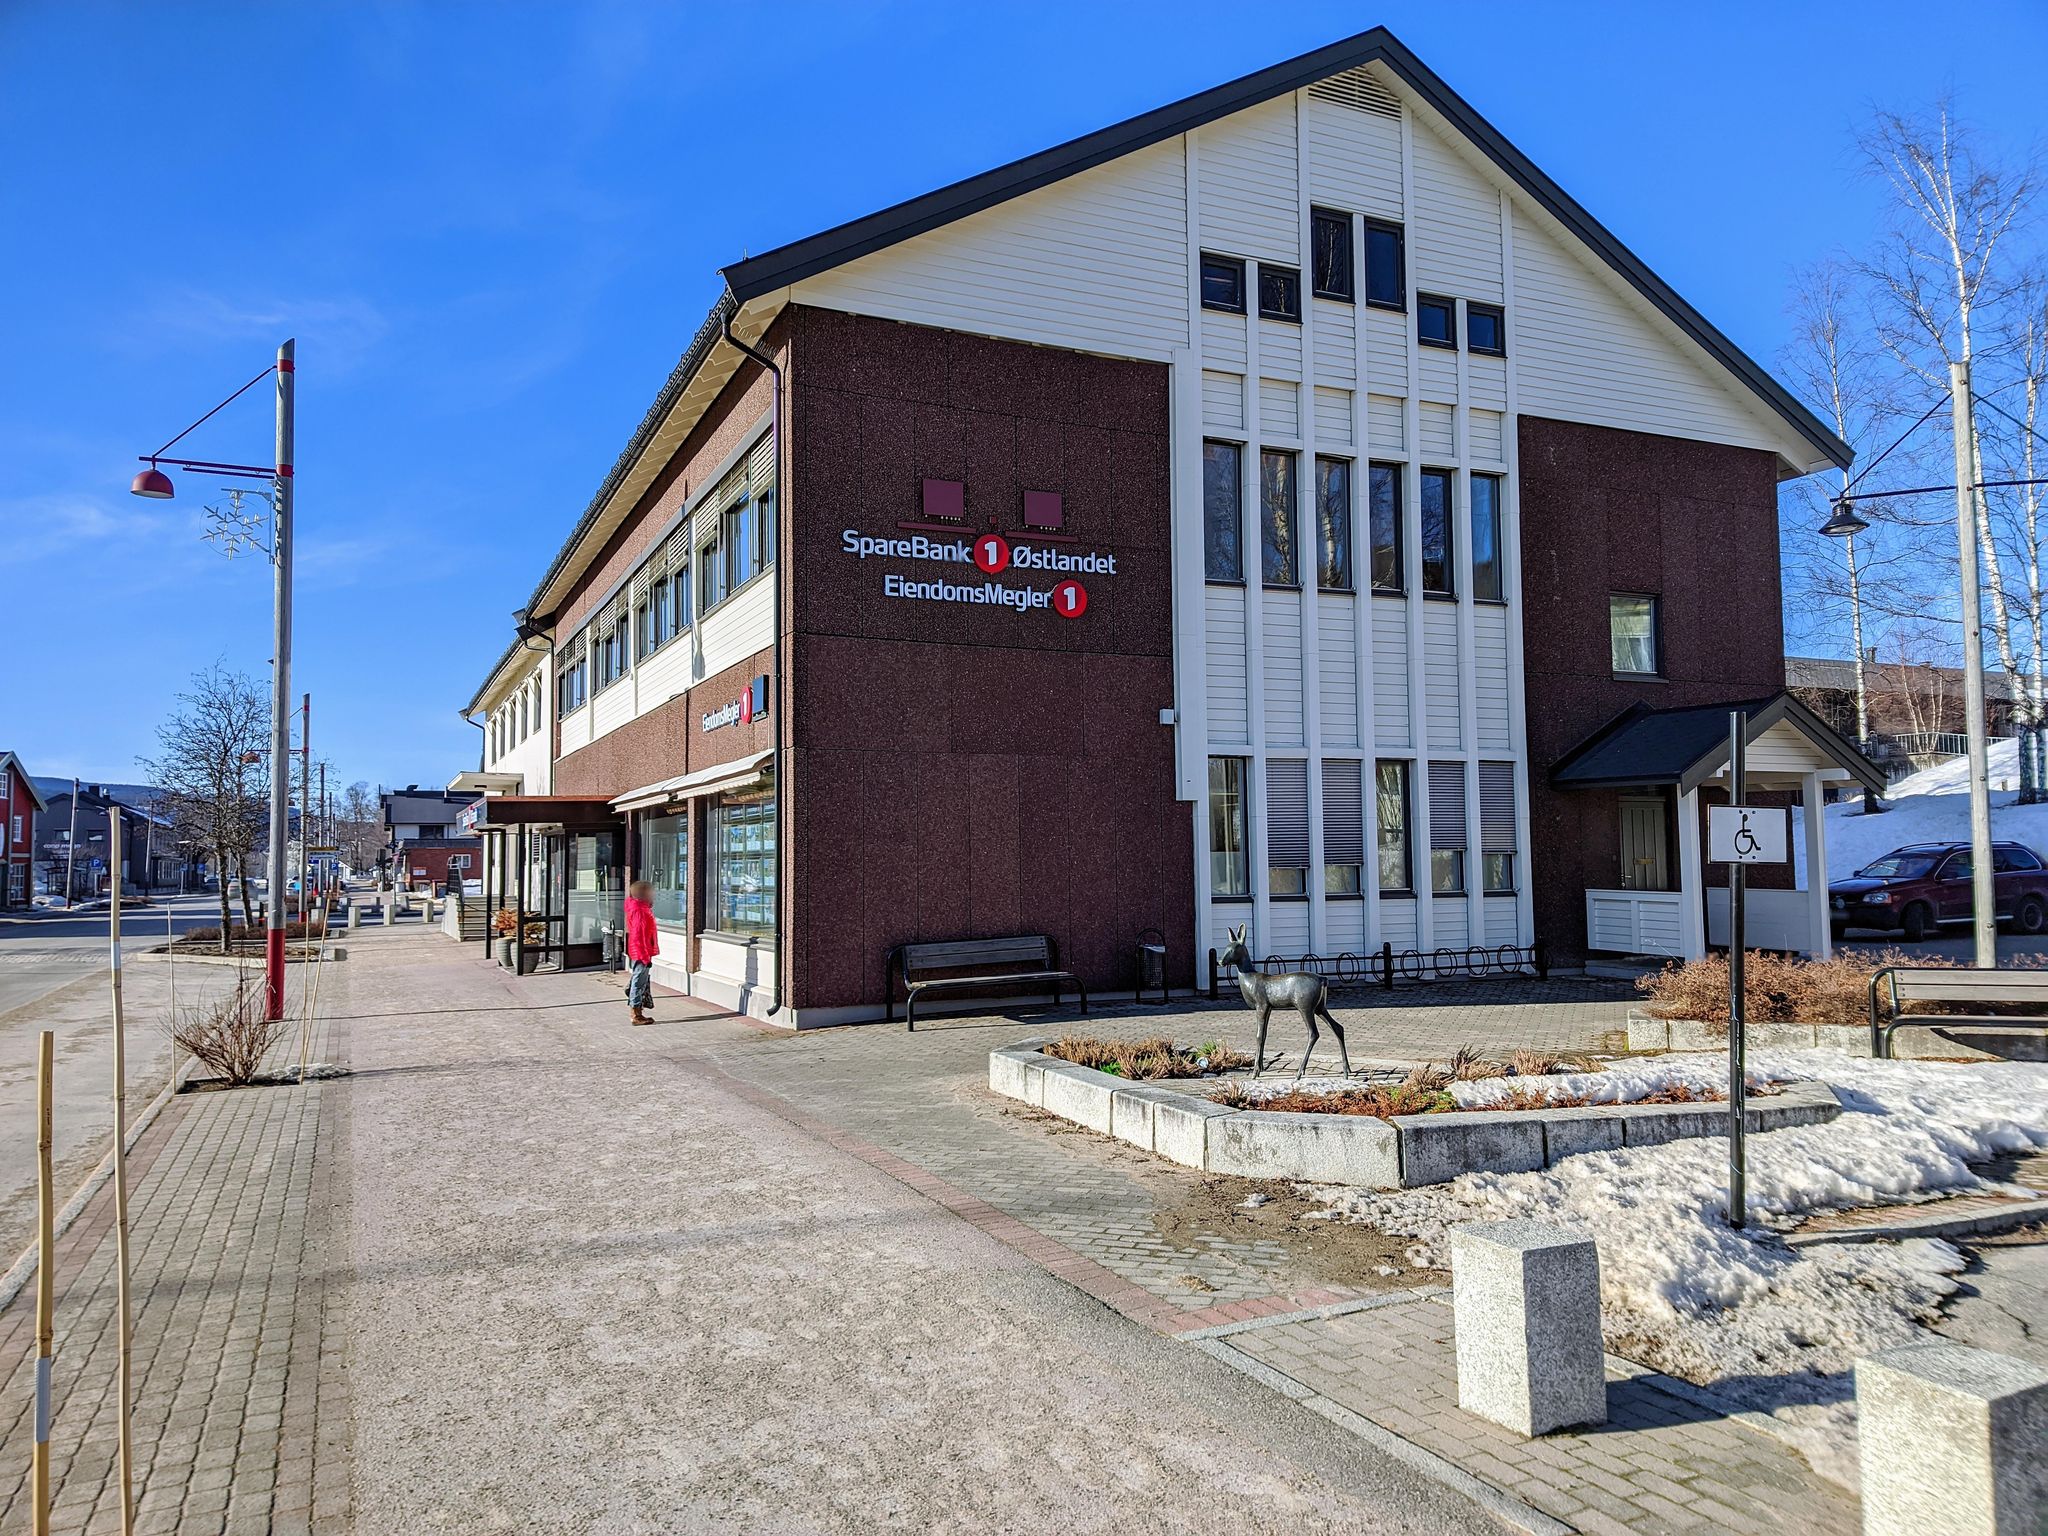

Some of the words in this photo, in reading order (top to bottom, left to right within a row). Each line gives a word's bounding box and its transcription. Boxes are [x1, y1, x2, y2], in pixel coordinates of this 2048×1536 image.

[842, 529, 971, 563] SpareBank
[982, 541, 998, 566] 1
[1013, 545, 1116, 575] Østlandet
[884, 575, 1051, 612] EiendomsMegler
[1063, 586, 1076, 611] 1
